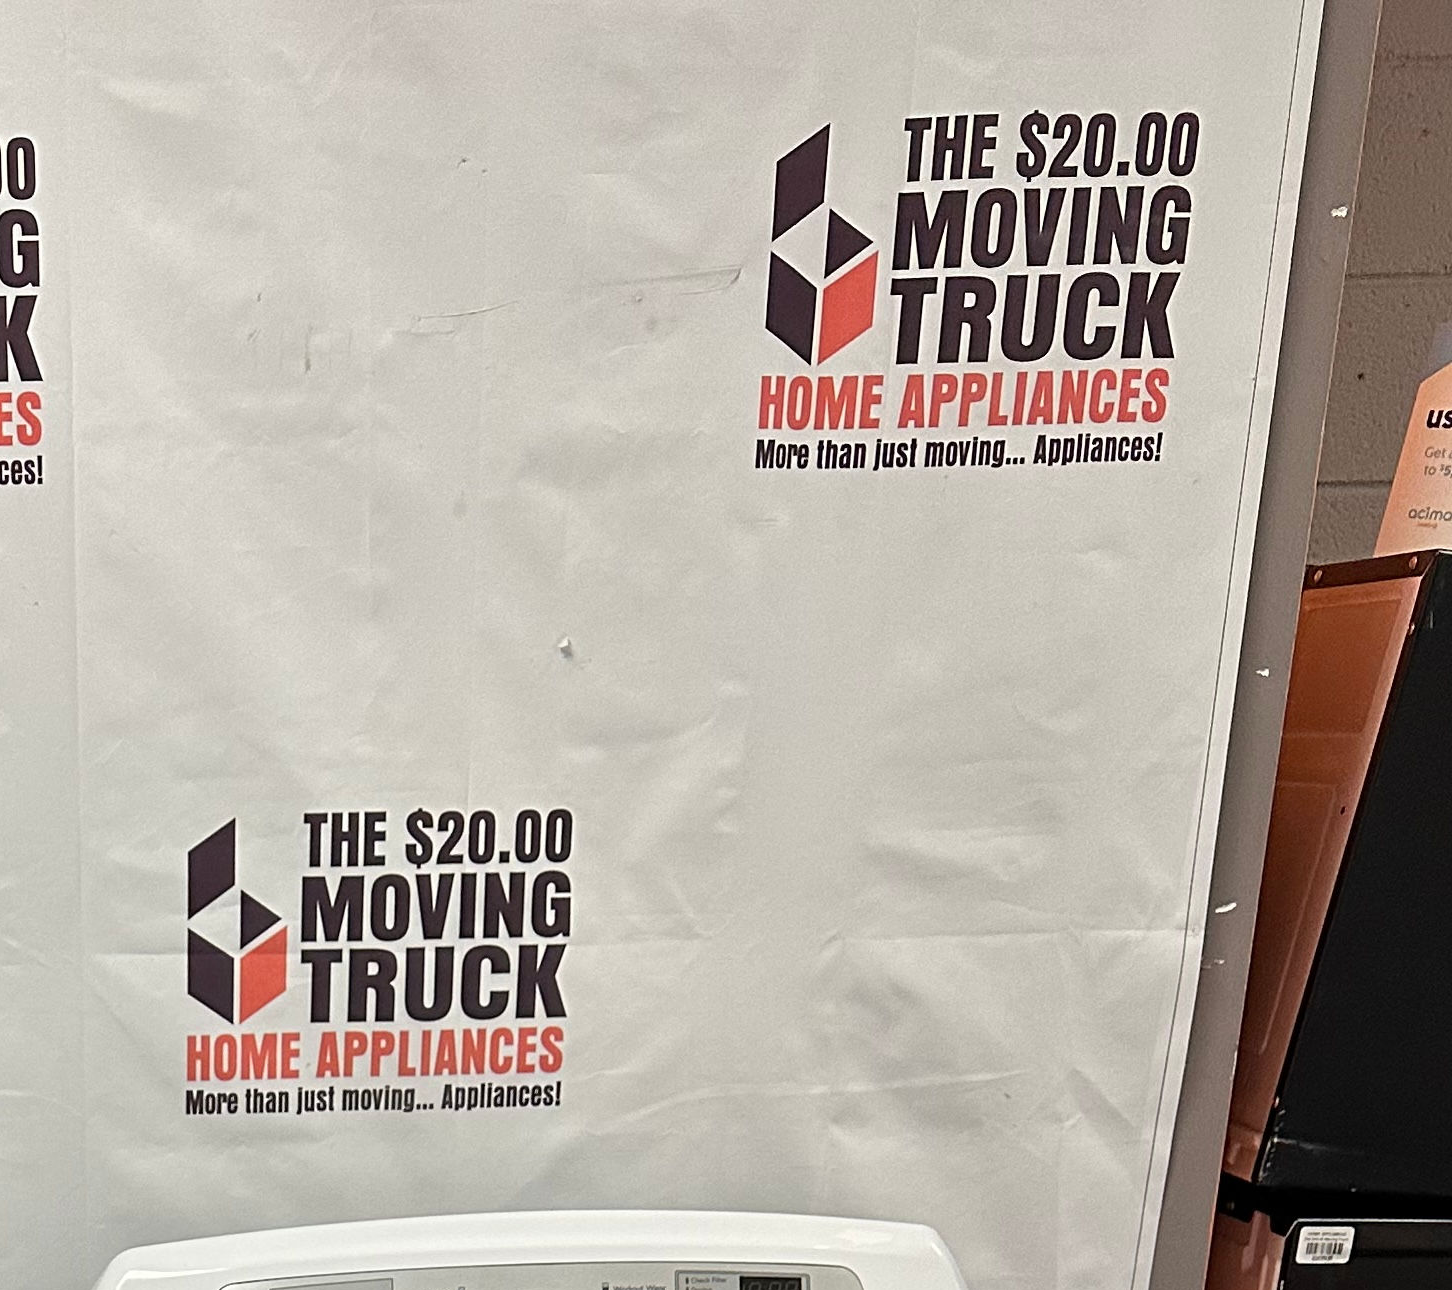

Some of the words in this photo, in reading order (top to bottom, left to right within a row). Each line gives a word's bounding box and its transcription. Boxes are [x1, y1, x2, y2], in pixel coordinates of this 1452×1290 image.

[905, 114, 999, 182] THE
[1016, 110, 1199, 182] $20.00
[892, 185, 1191, 270] MOVING
[890, 272, 1180, 364] TRUCK
[759, 375, 884, 431] HOME
[898, 368, 1169, 429] APPLIANCES
[755, 440, 809, 469] More
[817, 440, 866, 469] than
[873, 438, 917, 471] just
[924, 437, 1025, 468] moving...
[1033, 432, 1163, 466] Appliances!
[1424, 446, 1447, 459] Get
[304, 812, 386, 867] THE
[406, 808, 572, 869] $20.00
[301, 871, 571, 942] MOVING
[301, 944, 566, 1023] TRUCK
[187, 1032, 300, 1082] HOME
[316, 1026, 563, 1078] APPLIANCES
[186, 1090, 238, 1115] More
[246, 1089, 289, 1113] than
[297, 1086, 334, 1115] just
[342, 1086, 433, 1112] moving...
[441, 1081, 561, 1111] Appliances!
